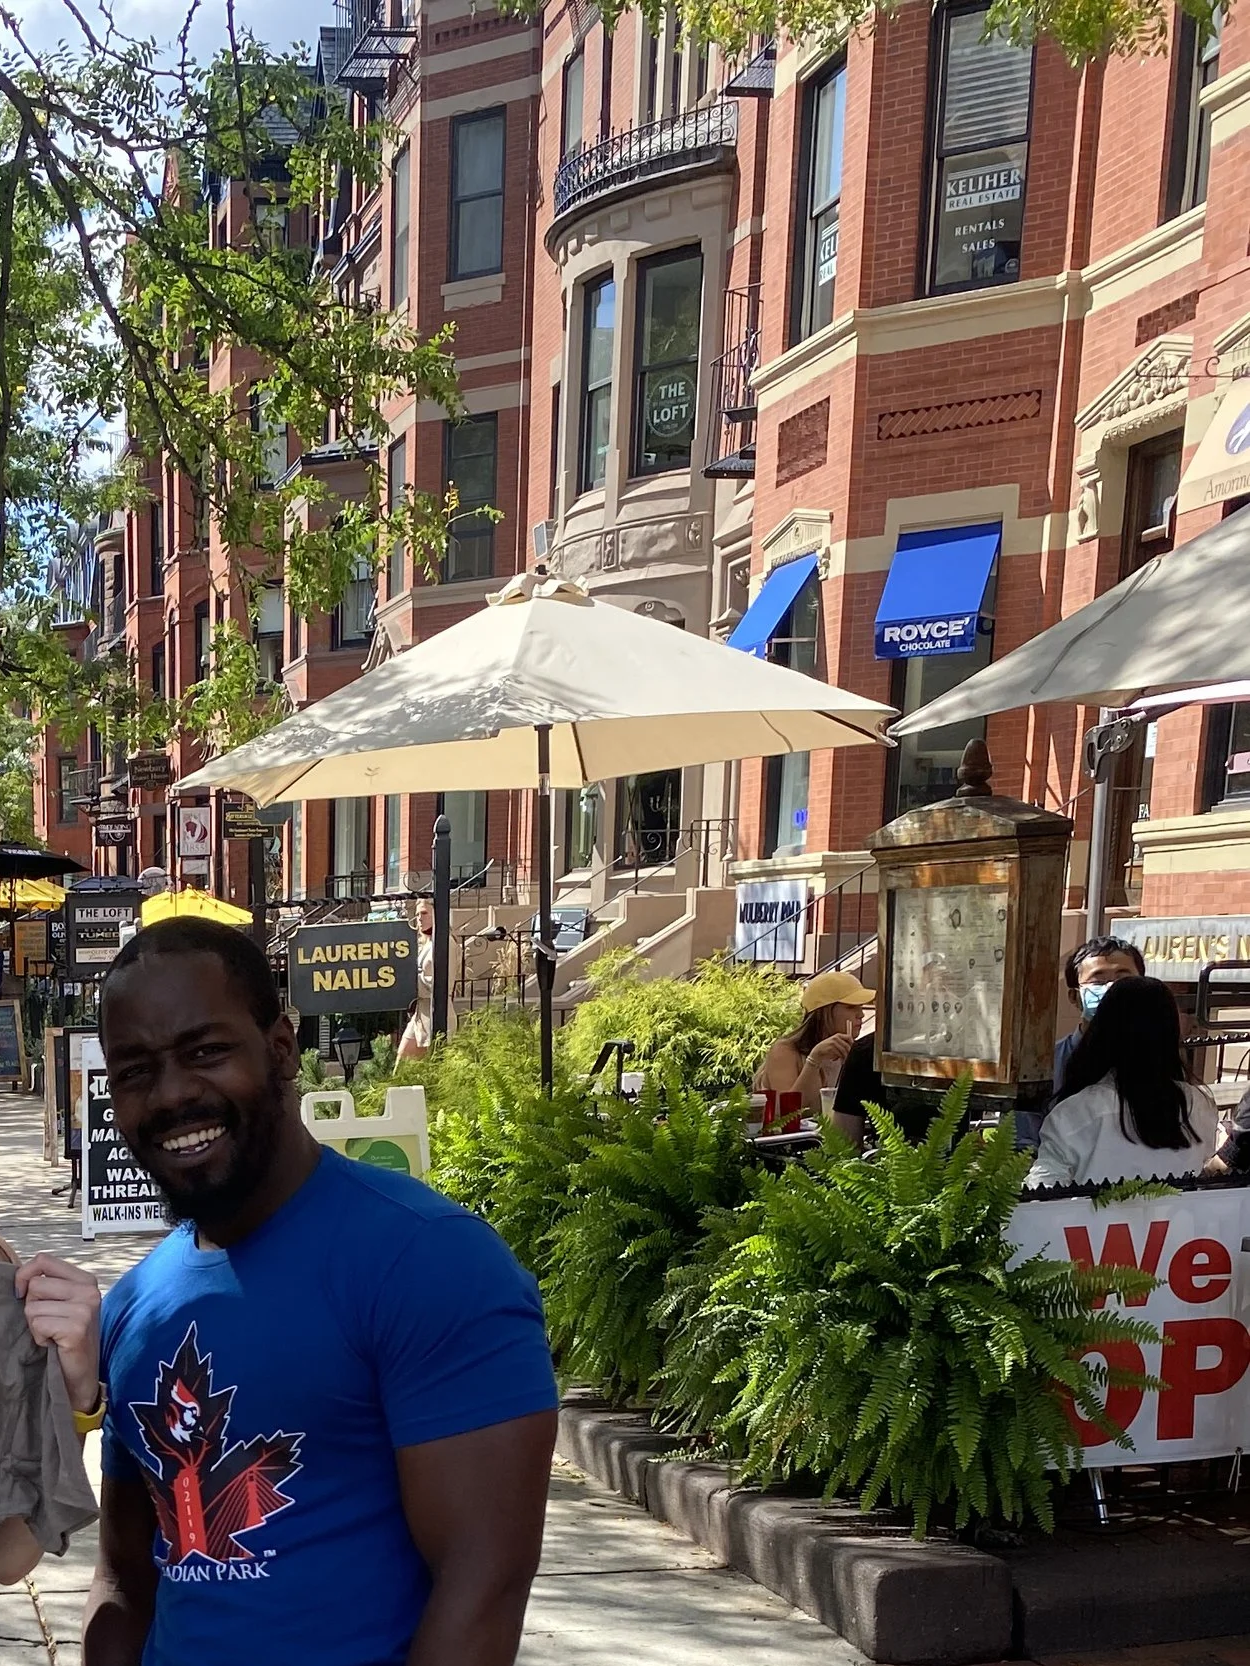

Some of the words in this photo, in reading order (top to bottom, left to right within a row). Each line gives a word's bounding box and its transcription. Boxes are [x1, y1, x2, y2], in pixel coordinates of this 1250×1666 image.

[946, 168, 1021, 197] KELIHER
[949, 196, 974, 209] REAL
[978, 188, 1017, 204] ESTATE
[954, 218, 1005, 237] RENTALS
[961, 238, 996, 254] SALES
[659, 381, 686, 399] THE
[653, 404, 689, 425] LOFT
[899, 639, 951, 652] CHOCOLATE
[79, 908, 98, 918] THE
[103, 907, 130, 918] LOFT
[739, 901, 778, 923] MULBERRY
[297, 941, 410, 964] LAUREN'S
[313, 966, 396, 992] NAILS
[92, 1205, 141, 1221] WALK-INS
[1064, 1220, 1233, 1310] We
[182, 1477, 196, 1544] 02119
[216, 1561, 270, 1580] PARK
